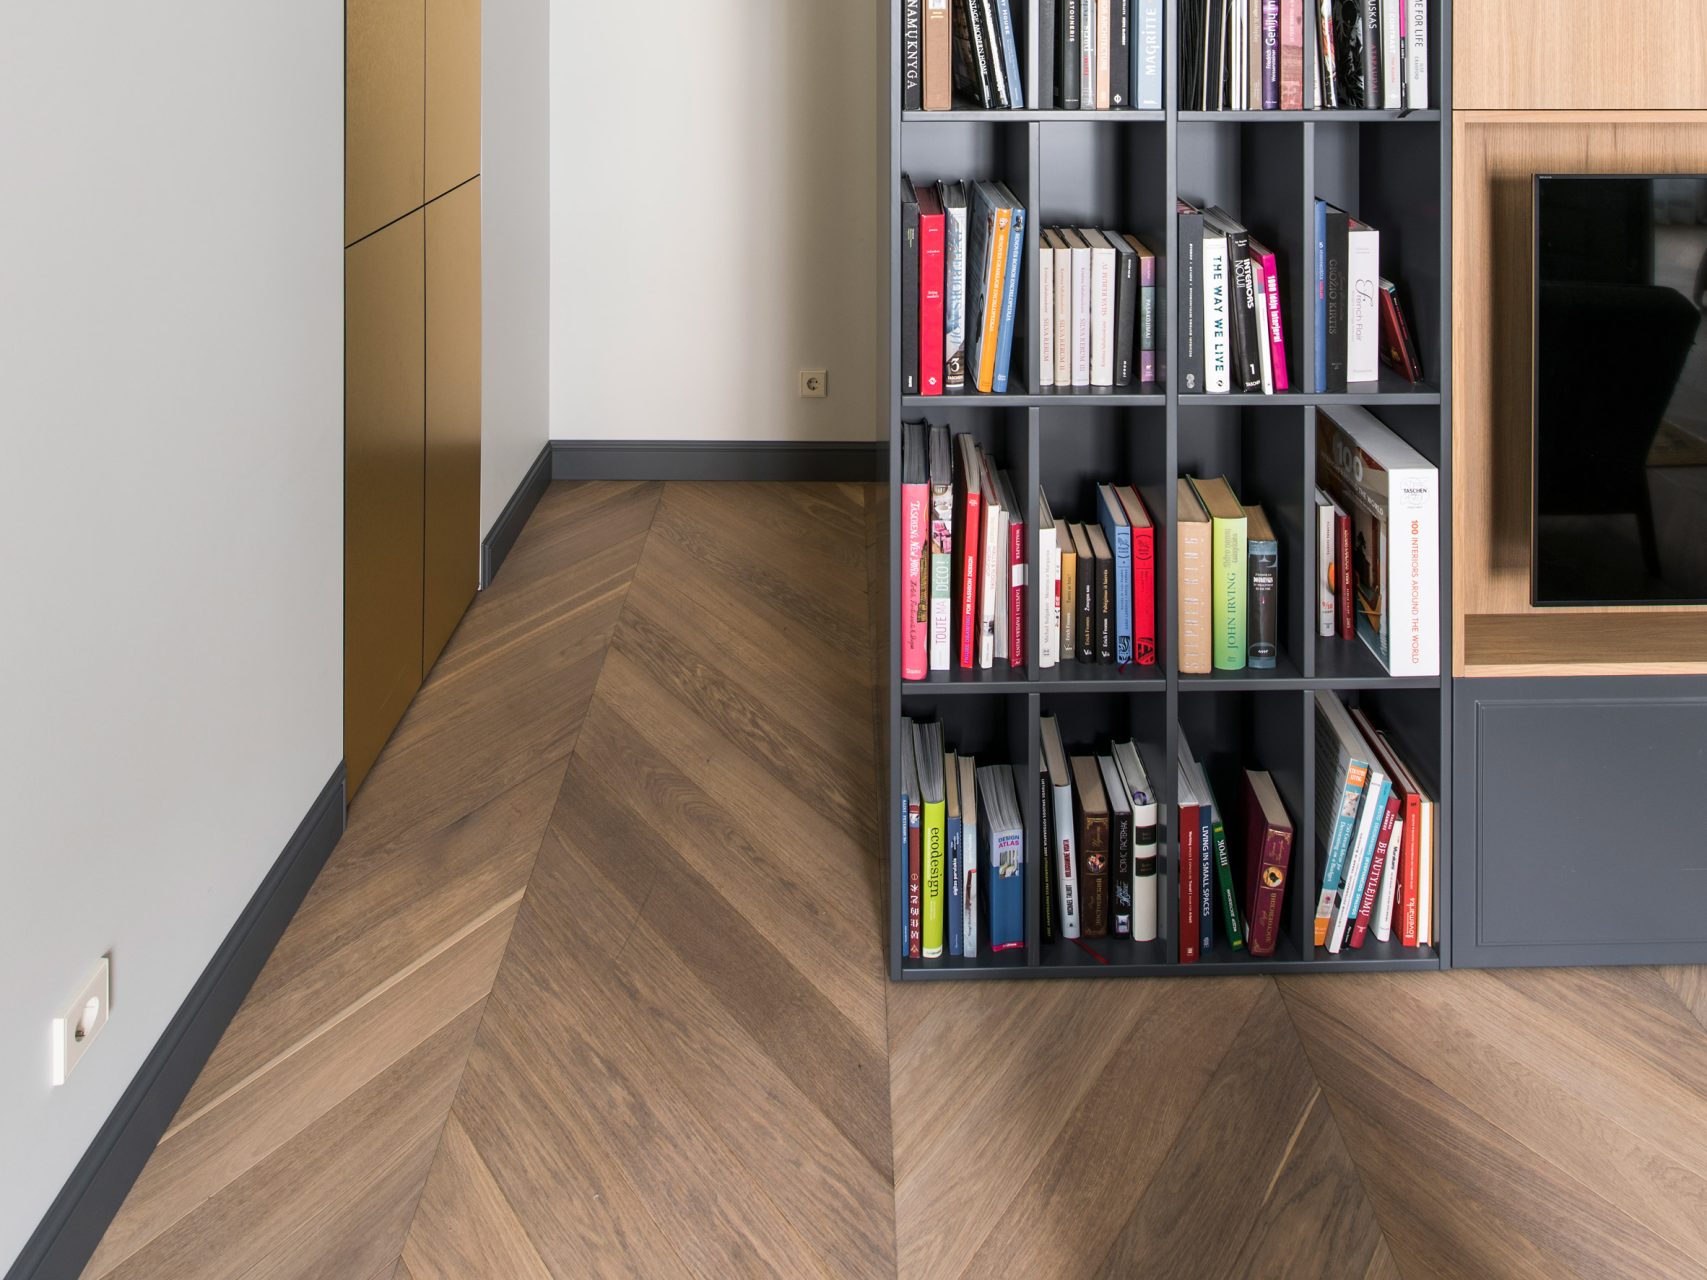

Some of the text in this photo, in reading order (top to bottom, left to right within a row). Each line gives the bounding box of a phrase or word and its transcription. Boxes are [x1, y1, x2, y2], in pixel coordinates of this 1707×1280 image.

[1001, 9, 1009, 35] HOUSE
[1414, 9, 1424, 26] FOR
[974, 24, 986, 52] MODERN
[1264, 14, 1277, 46] Genijų
[1414, 28, 1424, 47] LIFE
[1143, 8, 1161, 76] MAGRITTE
[979, 53, 988, 75] HOME
[1235, 260, 1246, 288] NOW!
[1243, 258, 1254, 310] INTERIORS
[1328, 259, 1339, 336] GROŽIO KIRTIS
[1212, 256, 1225, 372] THE WAY WE LIVE
[1356, 323, 1364, 342] Flair
[950, 357, 960, 373] 3
[1249, 363, 1255, 375] 1
[1367, 496, 1384, 516] WORLD
[1411, 519, 1419, 664] 100 INTERIORS AROUND THE WORLD
[935, 601, 947, 615] MA
[1227, 572, 1239, 649] JOHN IRVING
[935, 616, 947, 644] TOUTE
[998, 834, 1020, 843] DESIGN
[998, 840, 1020, 849] ATLAS
[1119, 820, 1128, 851] ПАСТЕРНАК
[1341, 833, 1351, 848] Great
[928, 827, 941, 898] ecodesign
[1202, 852, 1209, 861] IN
[1337, 848, 1347, 863] Ideas
[1390, 845, 1398, 870] Murakami
[1325, 862, 1336, 883] Budget
[1359, 840, 1387, 917] BE NUTYLĖJIMŲ
[1065, 884, 1073, 899] TALBOT
[1066, 899, 1074, 916] MICHAEL
[1405, 897, 1416, 939] lovemarks
